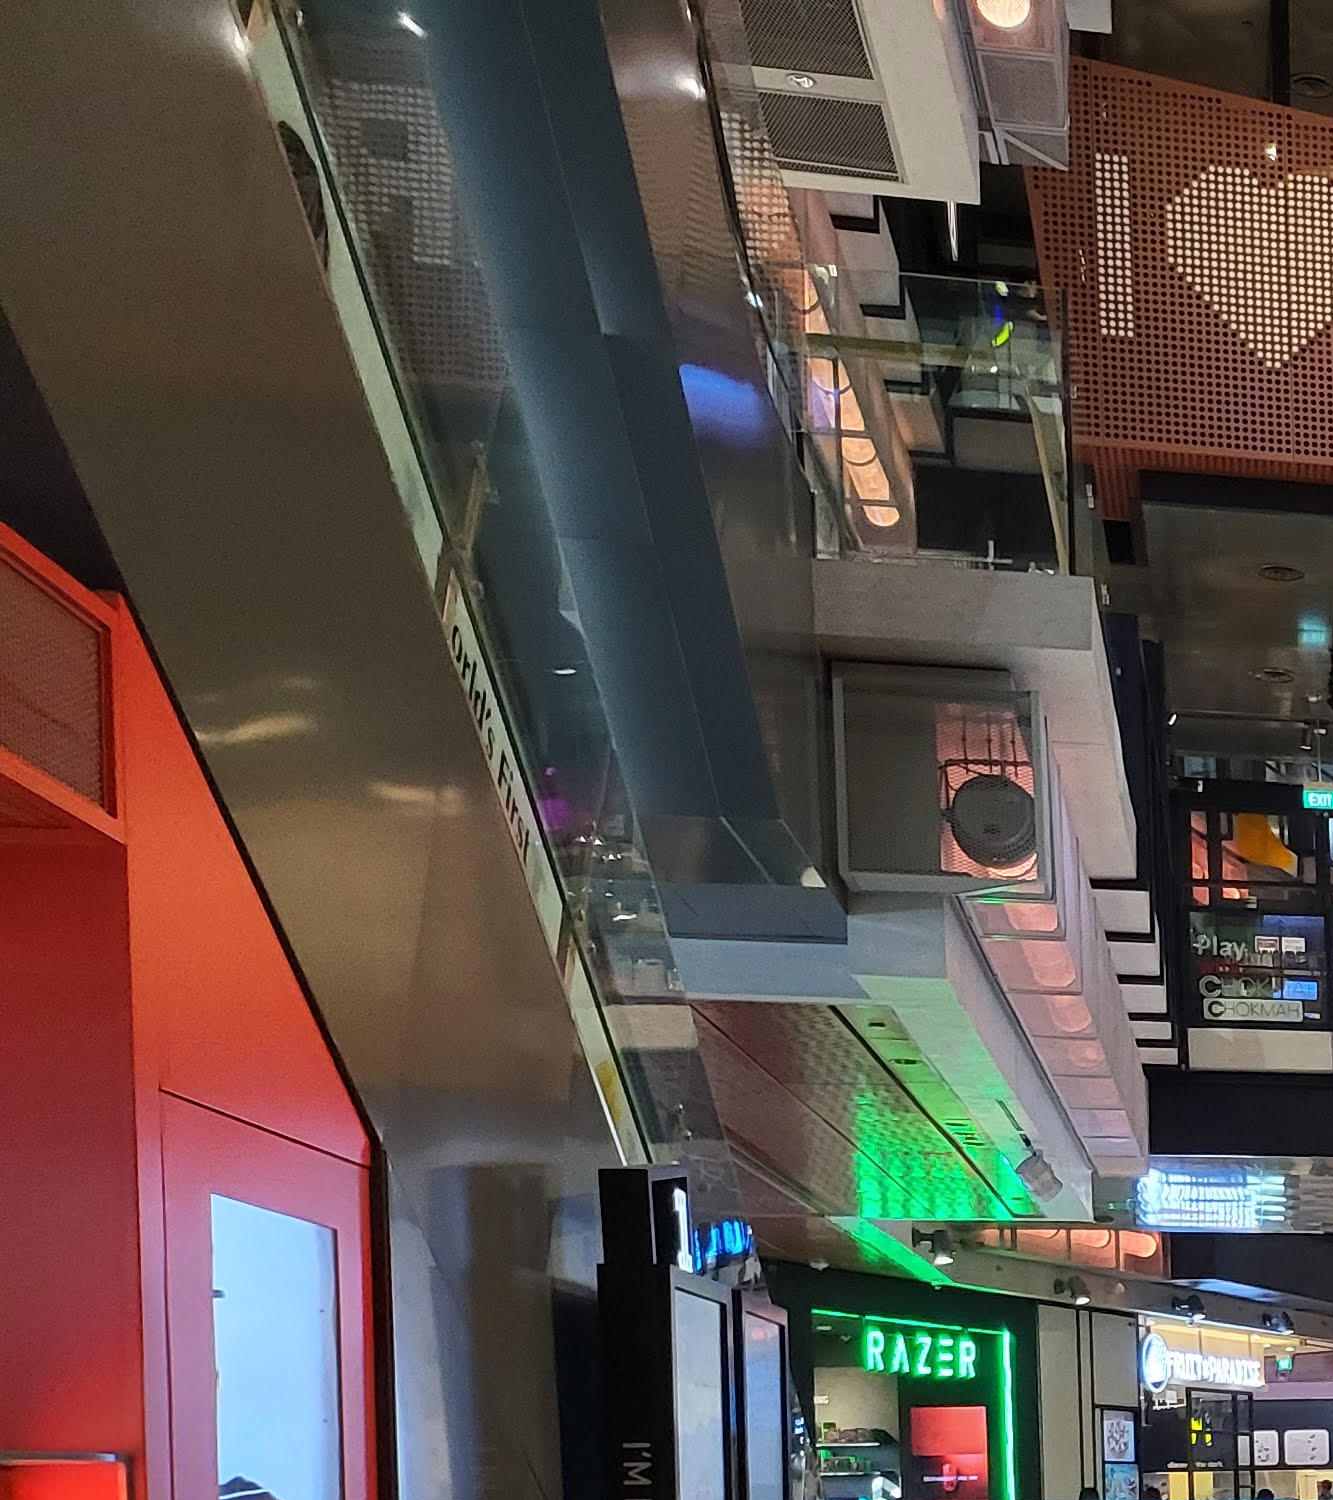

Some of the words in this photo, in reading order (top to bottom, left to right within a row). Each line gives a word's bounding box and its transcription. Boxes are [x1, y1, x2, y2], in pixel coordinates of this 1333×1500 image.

[1095, 153, 1135, 339] I
[1307, 792, 1333, 807] EXIT
[1207, 1000, 1300, 1018] CHOKMAH
[865, 1330, 976, 1379] RAZER
[1165, 1350, 1202, 1381] FRUIT
[621, 1441, 653, 1486] I'M
